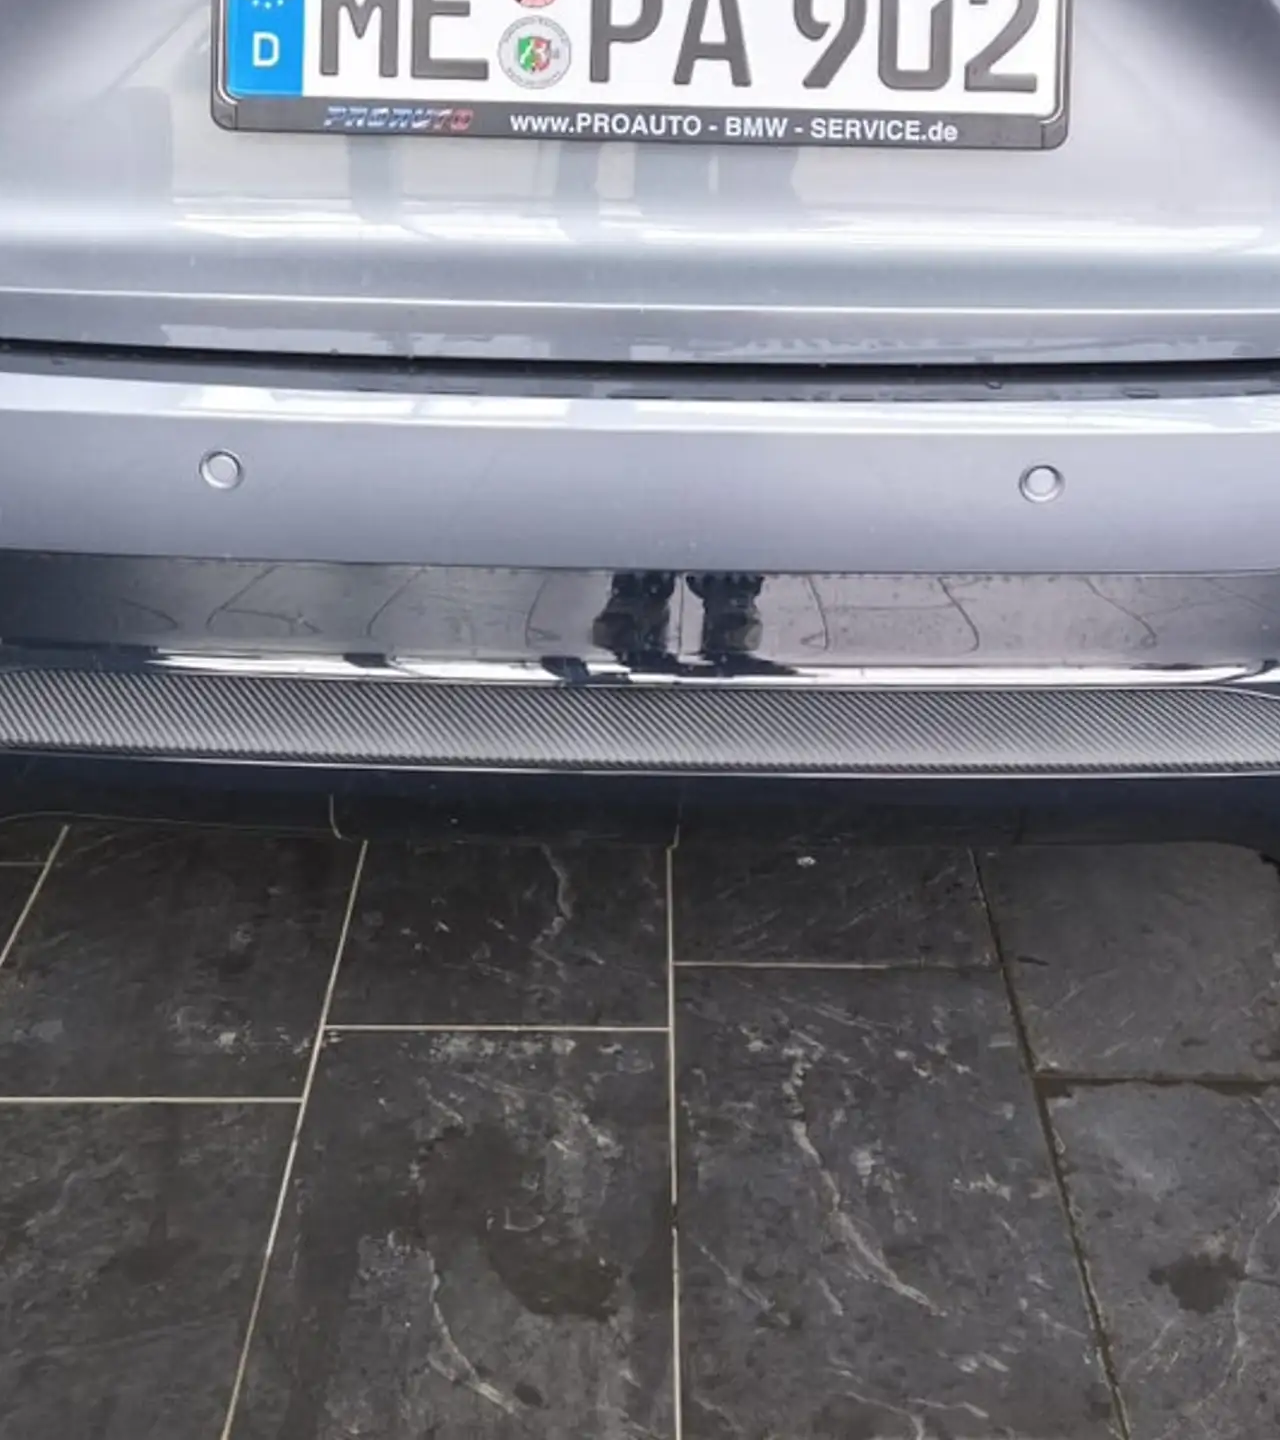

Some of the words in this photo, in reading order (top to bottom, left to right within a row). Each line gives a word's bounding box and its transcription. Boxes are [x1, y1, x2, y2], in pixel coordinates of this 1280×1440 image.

[252, 32, 281, 68] D
[323, 105, 474, 131] PROAUTO
[509, 113, 702, 137] www.PROAUTO
[725, 117, 788, 138] BMW
[810, 119, 959, 142] SERVICE.de
